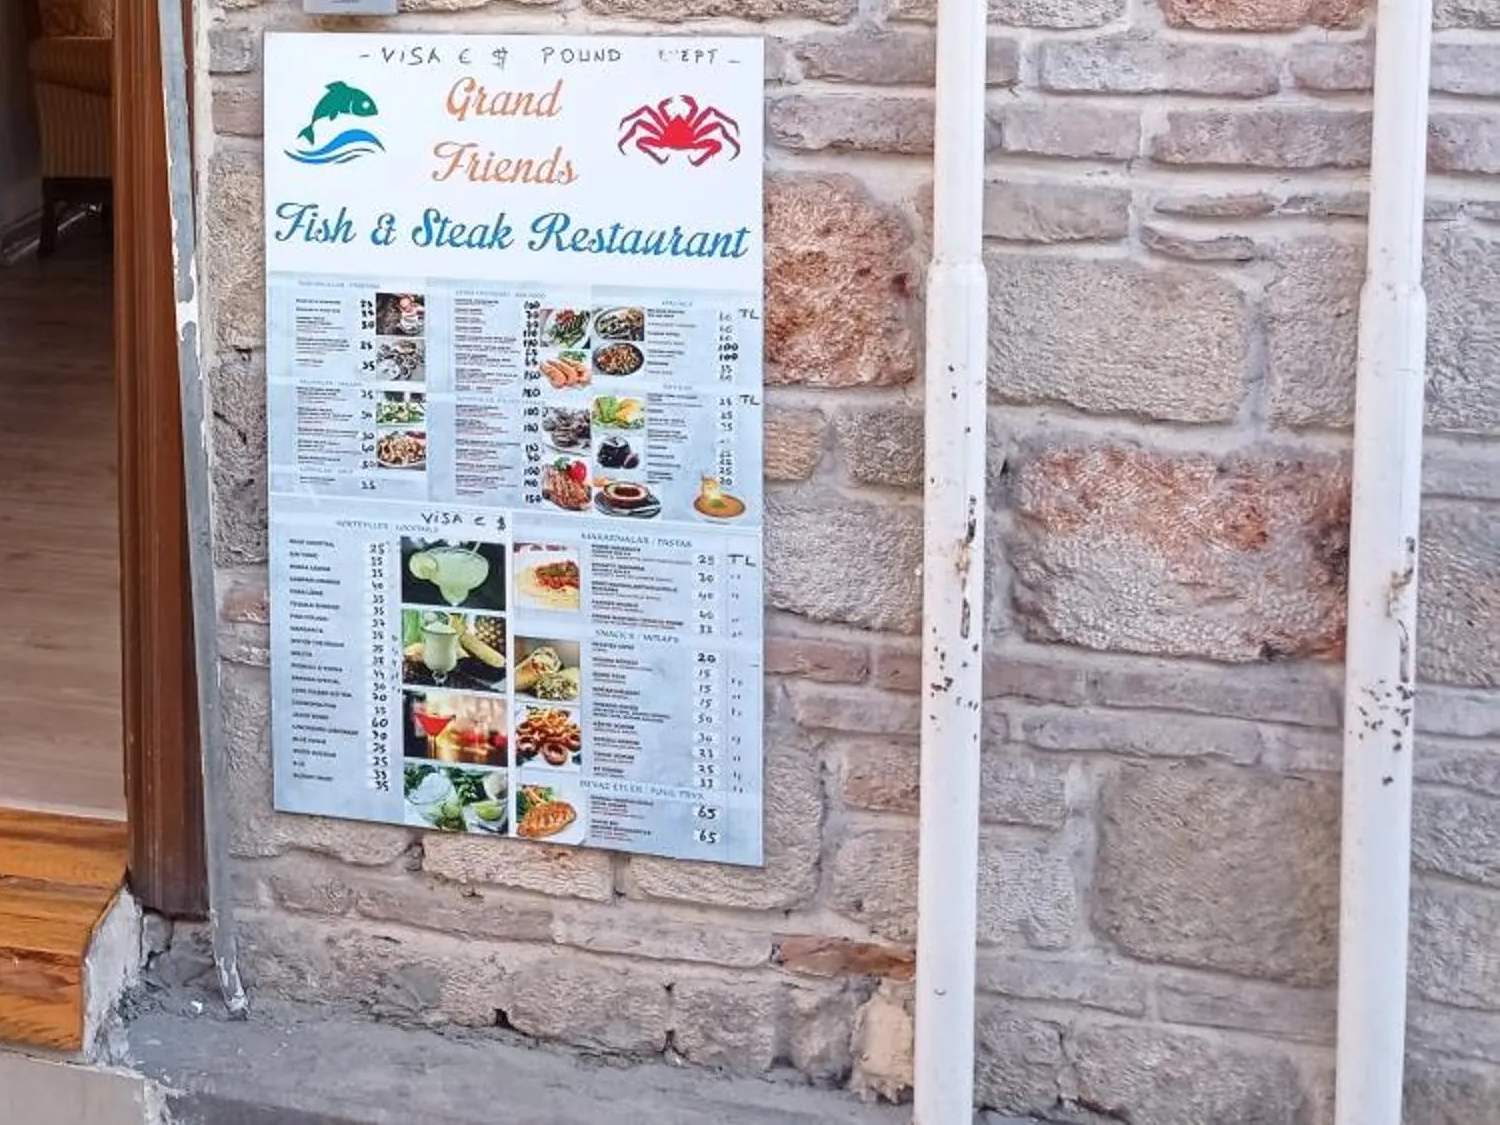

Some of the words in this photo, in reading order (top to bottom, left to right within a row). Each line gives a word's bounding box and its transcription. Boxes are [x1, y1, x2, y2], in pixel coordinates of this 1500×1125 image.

[541, 46, 621, 64] POUND
[446, 76, 564, 121] Grand
[431, 140, 579, 185] Friends
[275, 201, 357, 244] Fish
[370, 212, 397, 246] &
[411, 207, 515, 250] Steak
[528, 212, 751, 258] Restaurant
[739, 308, 759, 319] TL
[740, 395, 759, 405] TL
[728, 553, 756, 567] TL
[698, 652, 716, 663] 20
[699, 669, 711, 678] 15
[699, 684, 712, 693] 15
[700, 698, 712, 709] 15
[372, 717, 389, 728] 60
[698, 805, 717, 820] 65
[700, 830, 717, 844] 65
